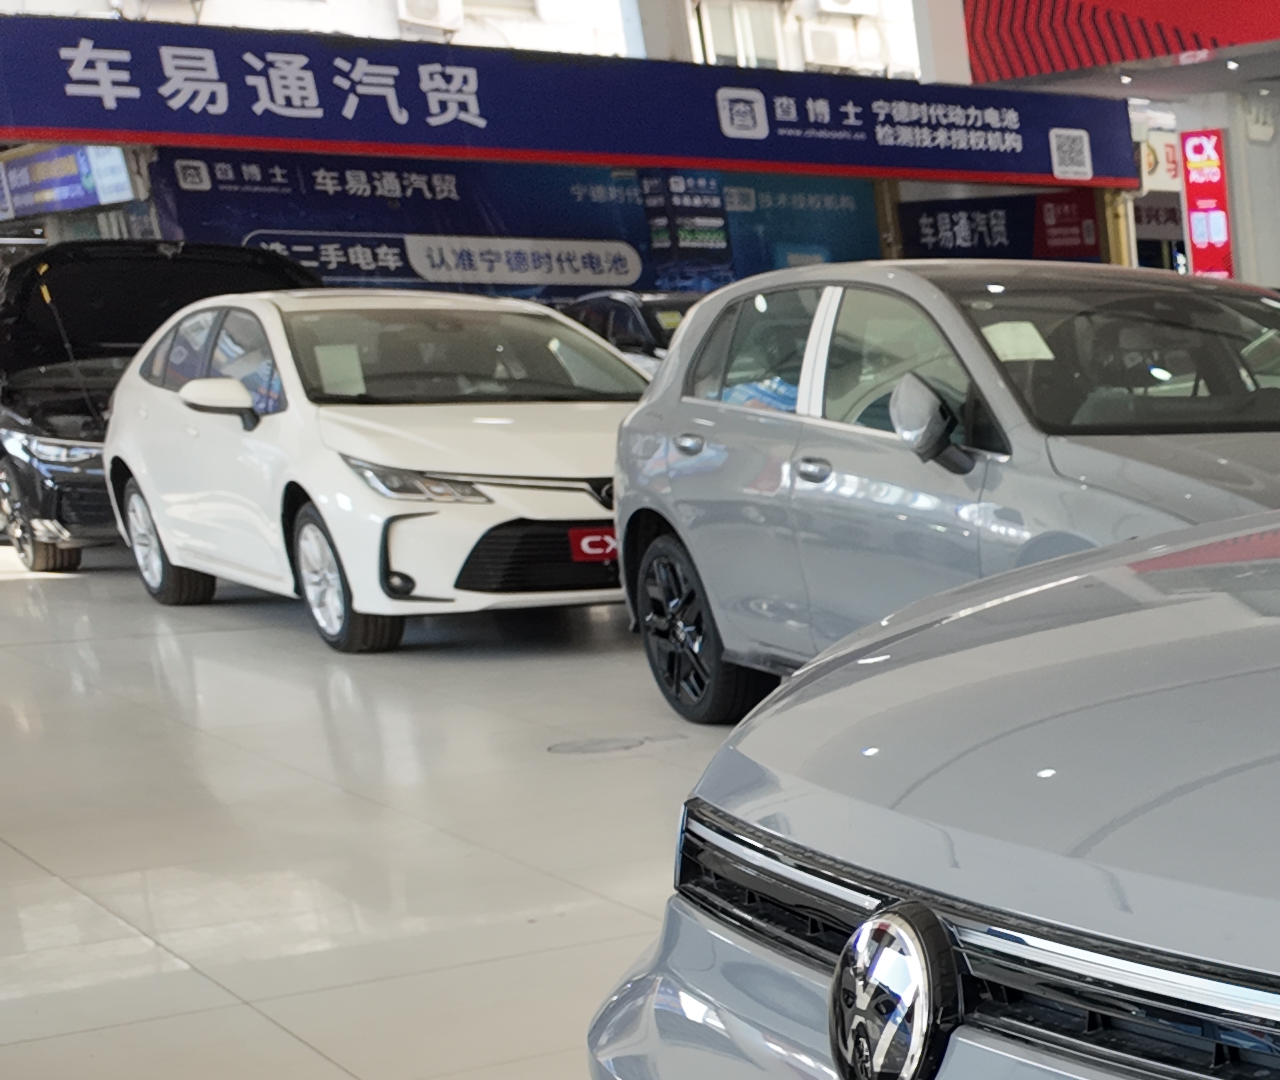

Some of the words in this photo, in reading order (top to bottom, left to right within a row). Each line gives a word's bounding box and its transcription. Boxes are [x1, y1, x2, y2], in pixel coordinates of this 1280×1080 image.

[59, 38, 487, 129] 车易通汽贸
[1185, 136, 1219, 162] CX
[311, 167, 460, 201] 车易通汽贸
[918, 209, 1010, 250] 车易通汽贸
[425, 247, 630, 275] 认准宁德时代电池
